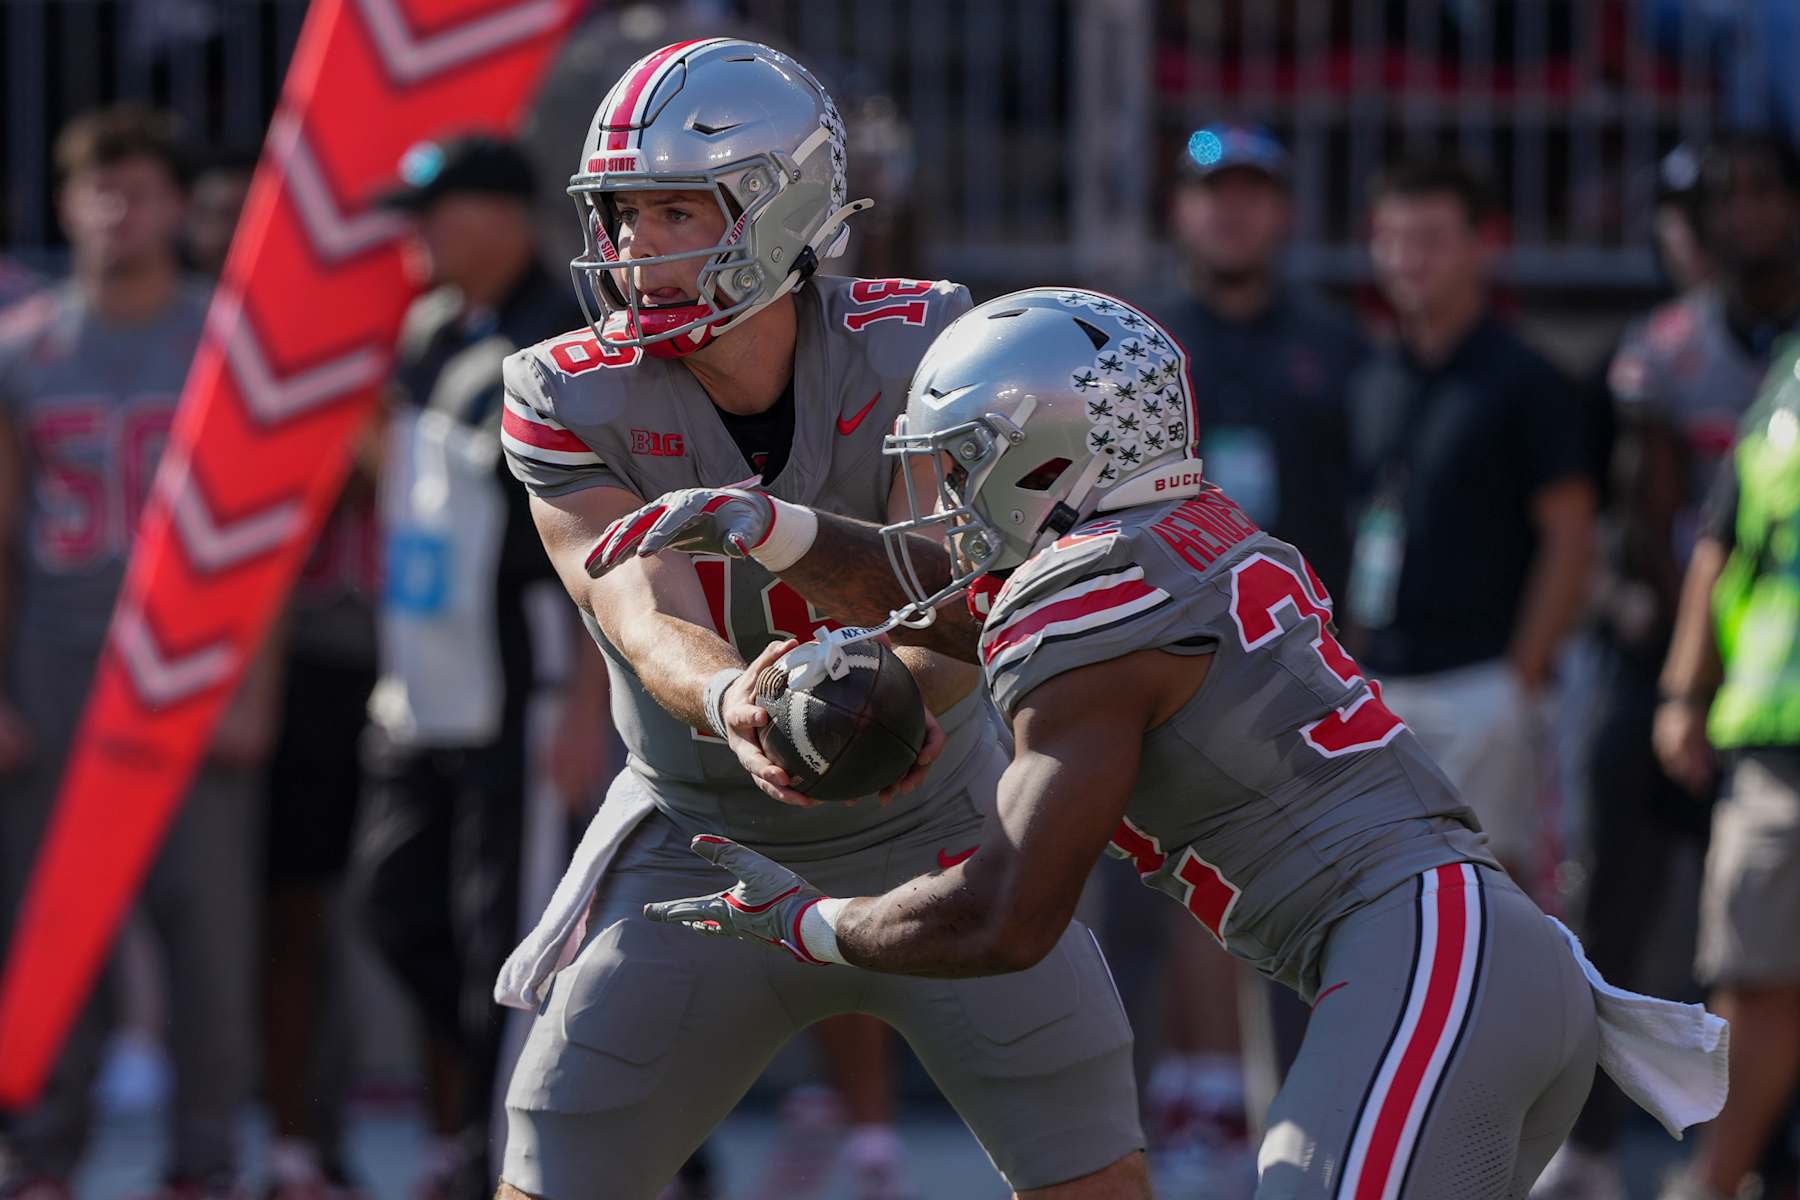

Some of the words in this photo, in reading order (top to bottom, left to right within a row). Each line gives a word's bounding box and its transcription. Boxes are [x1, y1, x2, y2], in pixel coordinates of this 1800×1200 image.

[608, 157, 637, 173] STATE
[843, 278, 934, 332] 18
[543, 318, 644, 378] 8
[1229, 552, 1408, 759] 3
